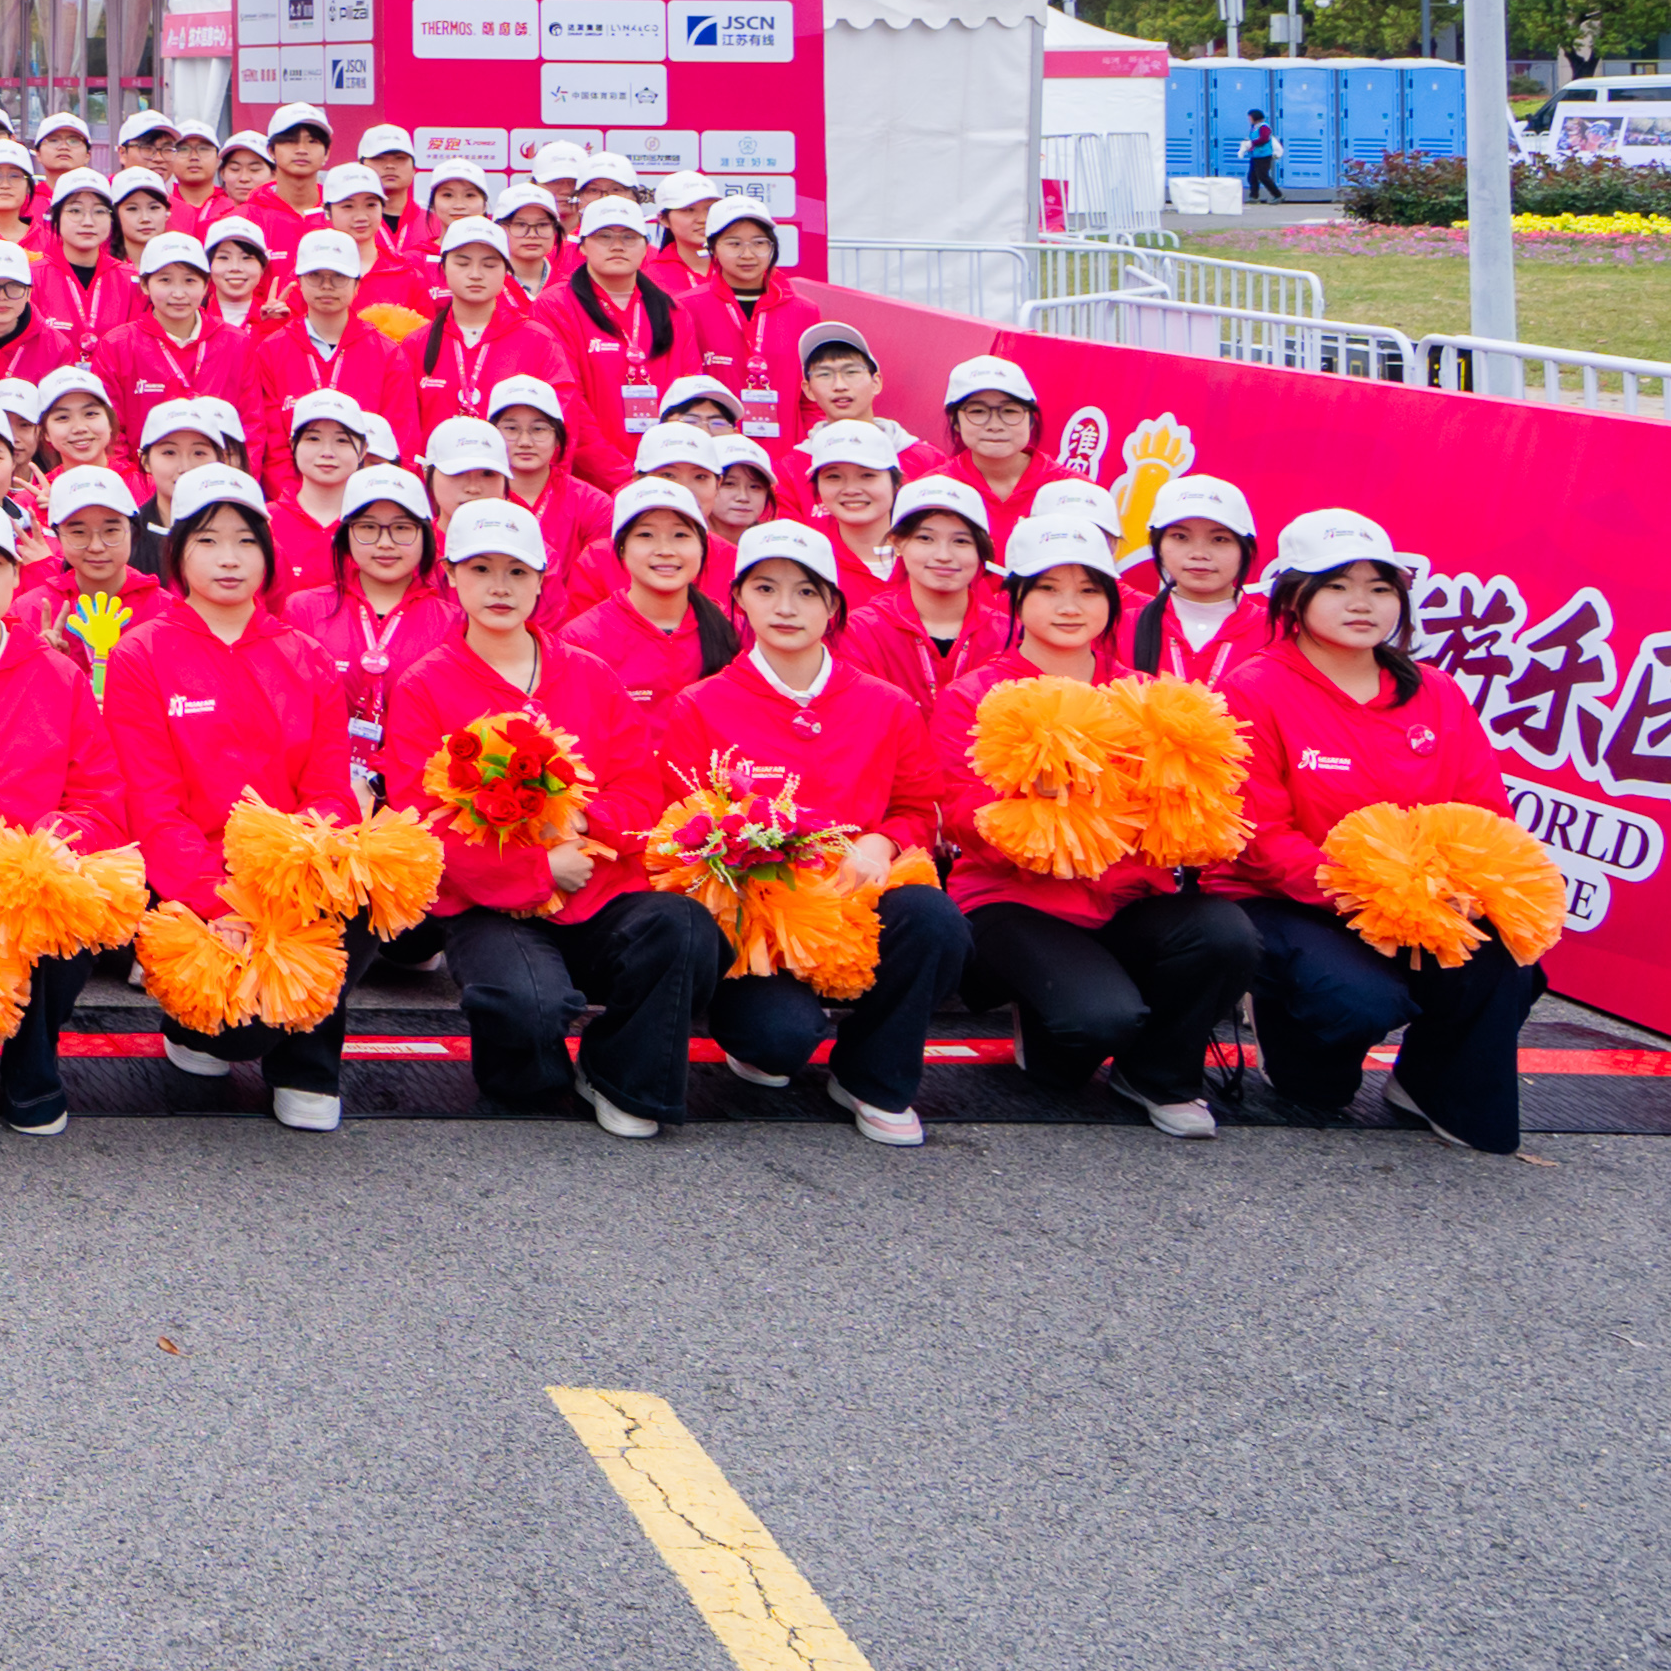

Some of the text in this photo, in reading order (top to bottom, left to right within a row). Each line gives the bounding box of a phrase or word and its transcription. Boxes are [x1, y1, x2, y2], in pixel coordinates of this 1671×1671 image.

[722, 15, 775, 30] JSCN
[721, 33, 775, 47] 江苏有线
[427, 137, 461, 151] 爱跑
[1496, 785, 1649, 870] ORLD
